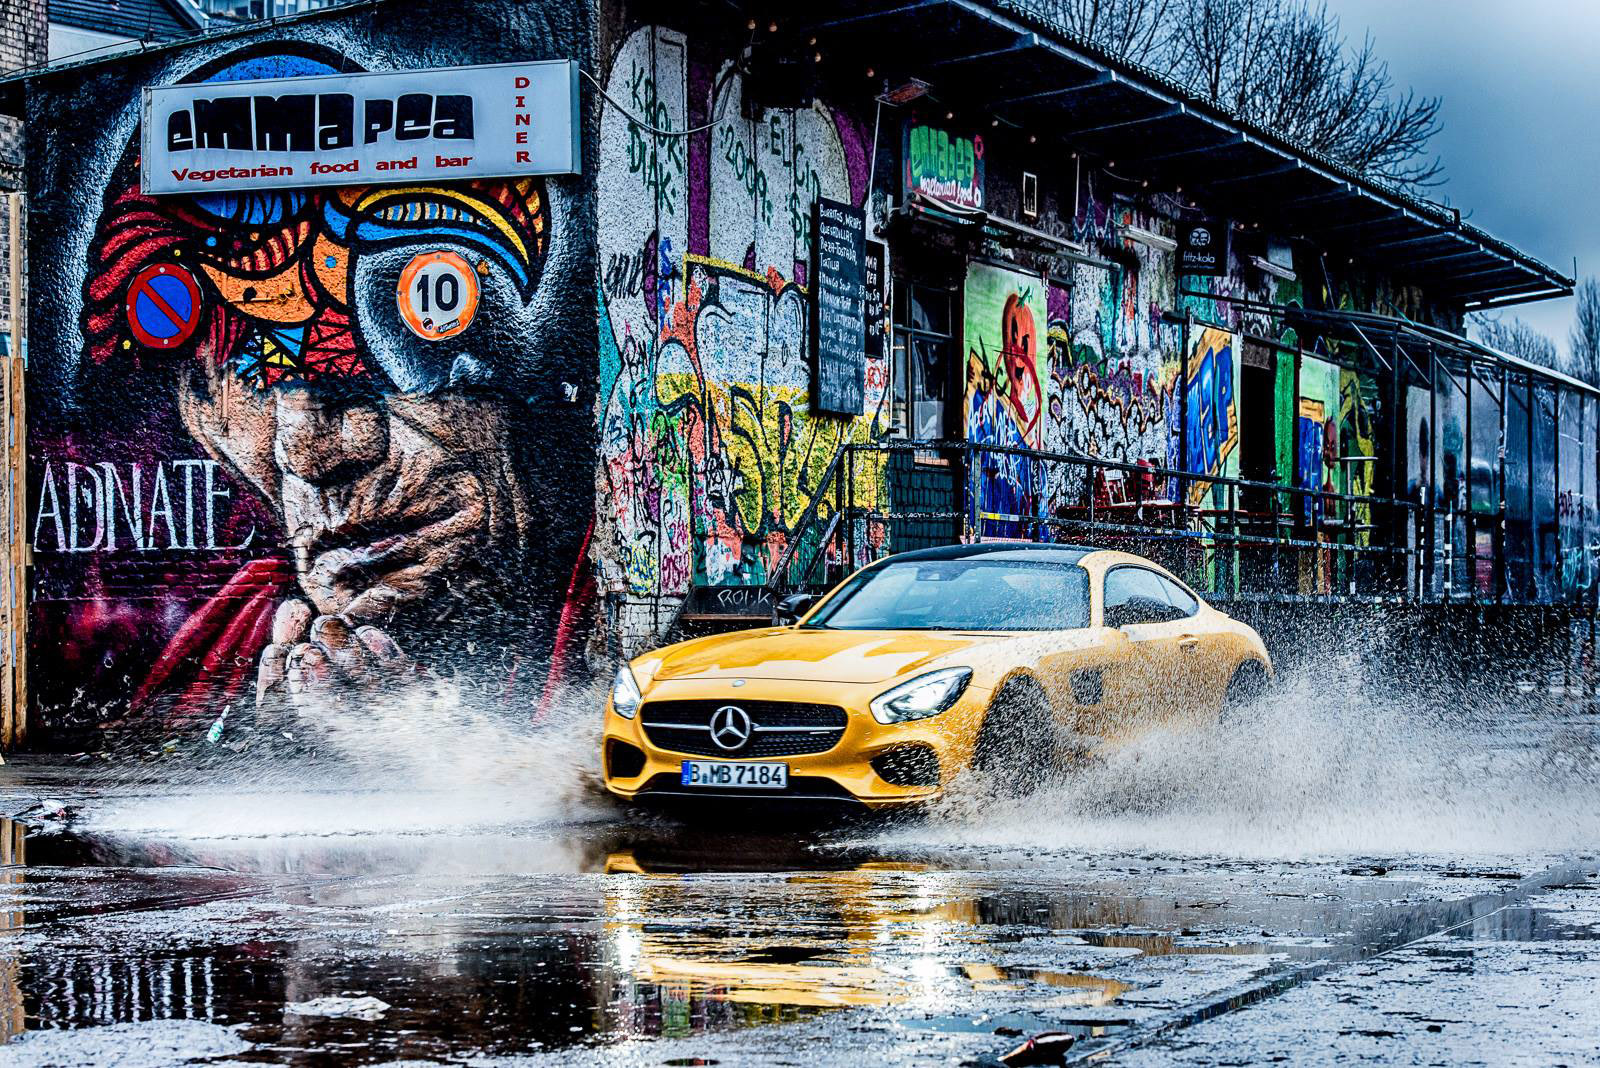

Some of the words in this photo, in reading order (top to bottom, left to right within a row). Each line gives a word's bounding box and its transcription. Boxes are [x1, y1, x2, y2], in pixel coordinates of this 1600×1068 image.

[167, 93, 354, 152] emma
[515, 77, 532, 163] DINER
[171, 163, 293, 183] Vegetarian
[310, 158, 359, 175] food
[375, 156, 418, 171] and
[435, 153, 474, 168] bar
[417, 273, 459, 312] 10
[34, 460, 256, 552] ADNATE
[736, 766, 782, 785] 7184
